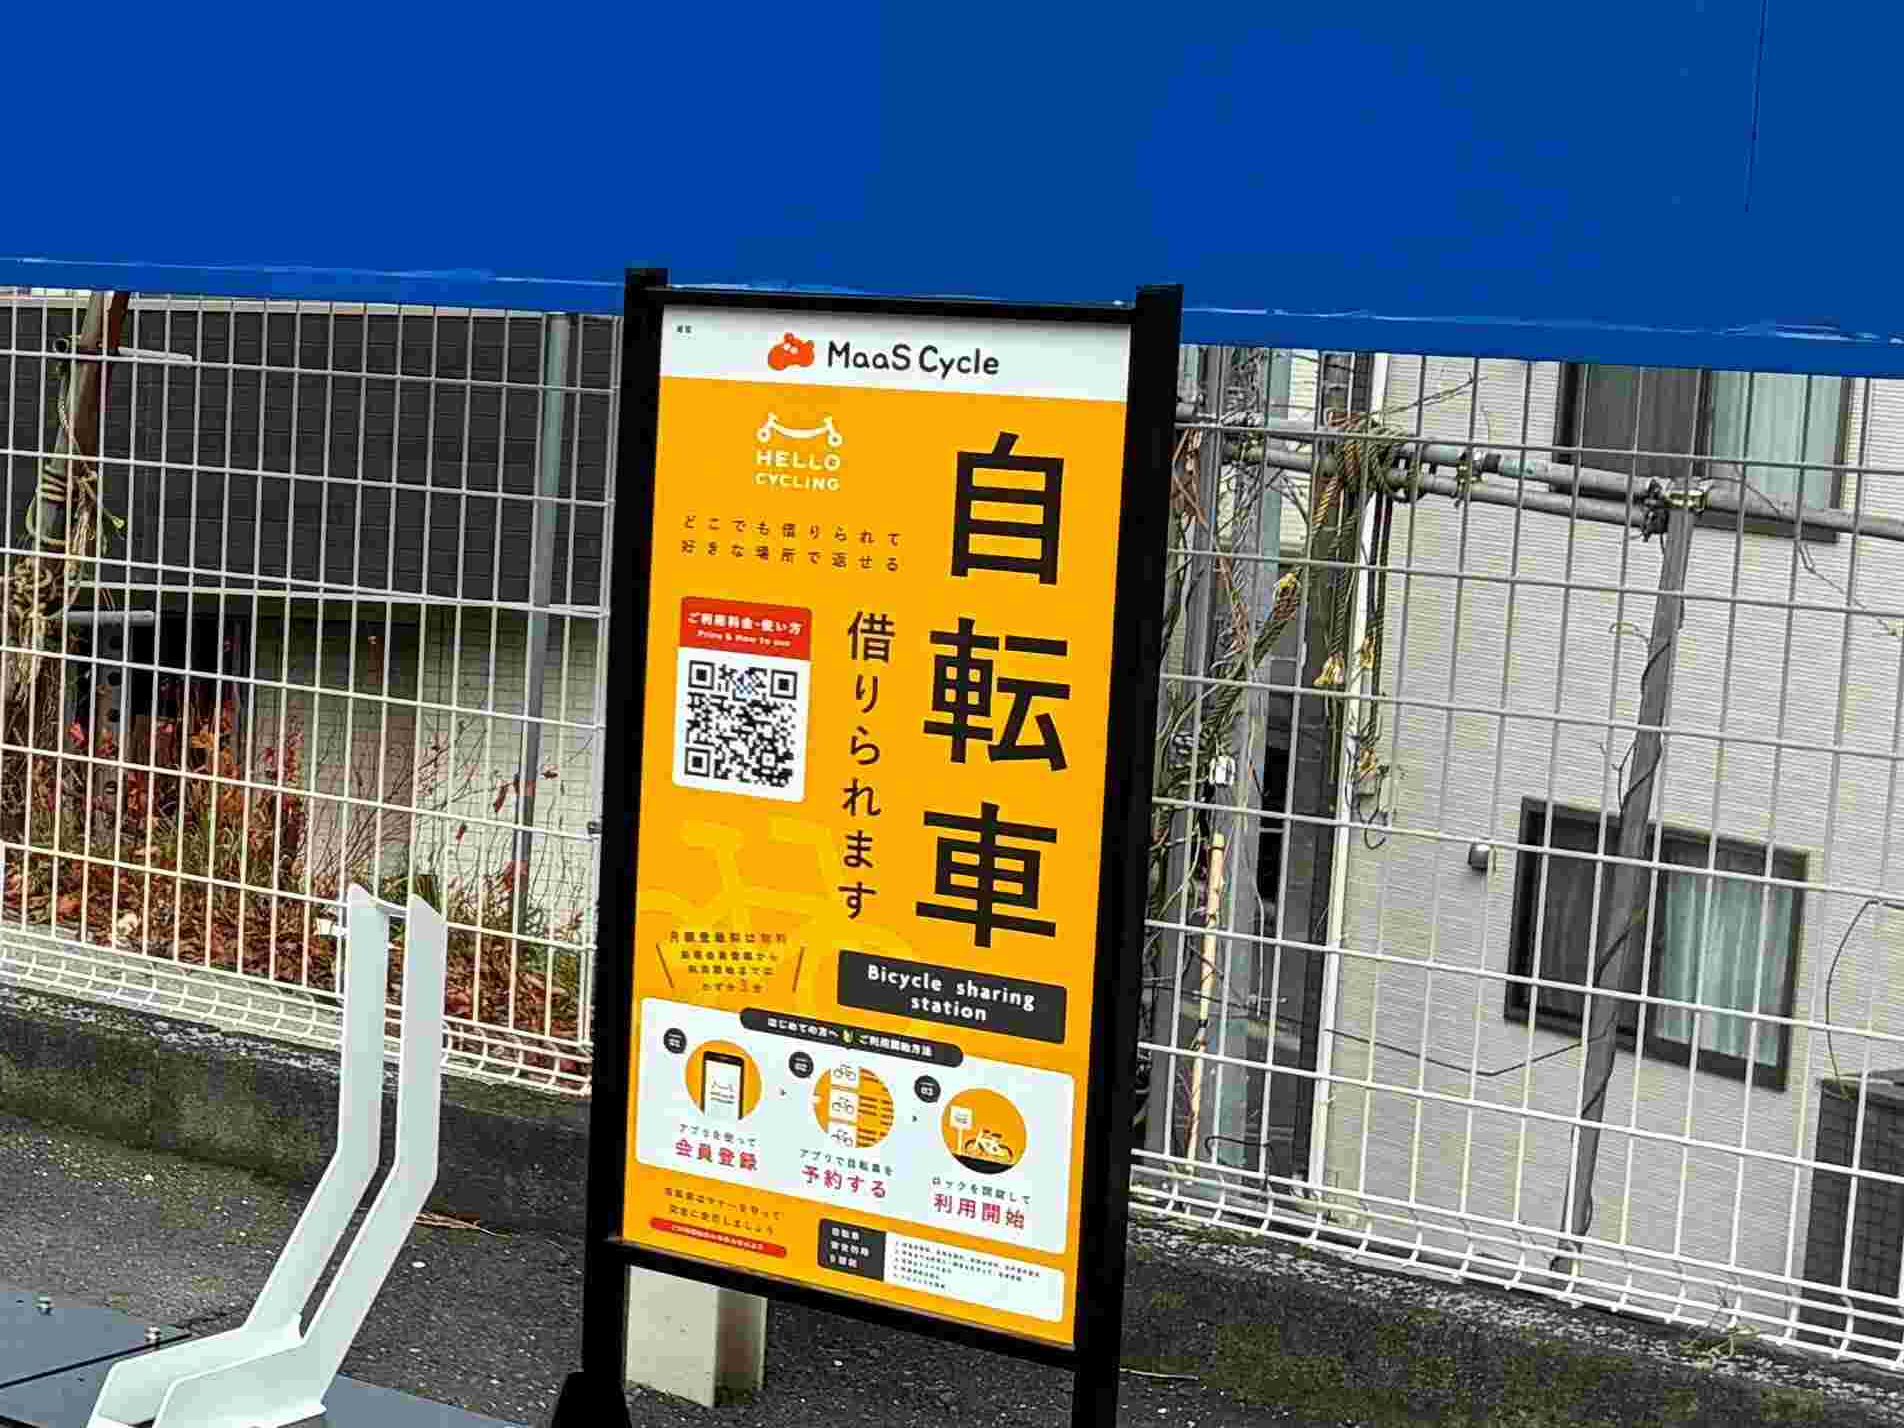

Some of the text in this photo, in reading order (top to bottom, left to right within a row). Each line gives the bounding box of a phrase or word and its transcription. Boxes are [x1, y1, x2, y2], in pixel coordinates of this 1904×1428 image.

[827, 340, 999, 380] MaaS Cycle
[756, 450, 841, 471] HELLO
[754, 472, 841, 492] CYCLING
[683, 514, 900, 547] どこでも借りられて
[915, 431, 1071, 948] 自転車
[837, 610, 896, 920] 借りられます
[867, 964, 1035, 1012] Bicycle sharing
[910, 996, 987, 1021] station
[675, 1138, 758, 1171] 会員登録
[802, 1164, 886, 1198] 予約する
[933, 1193, 1025, 1229] 利用開始
